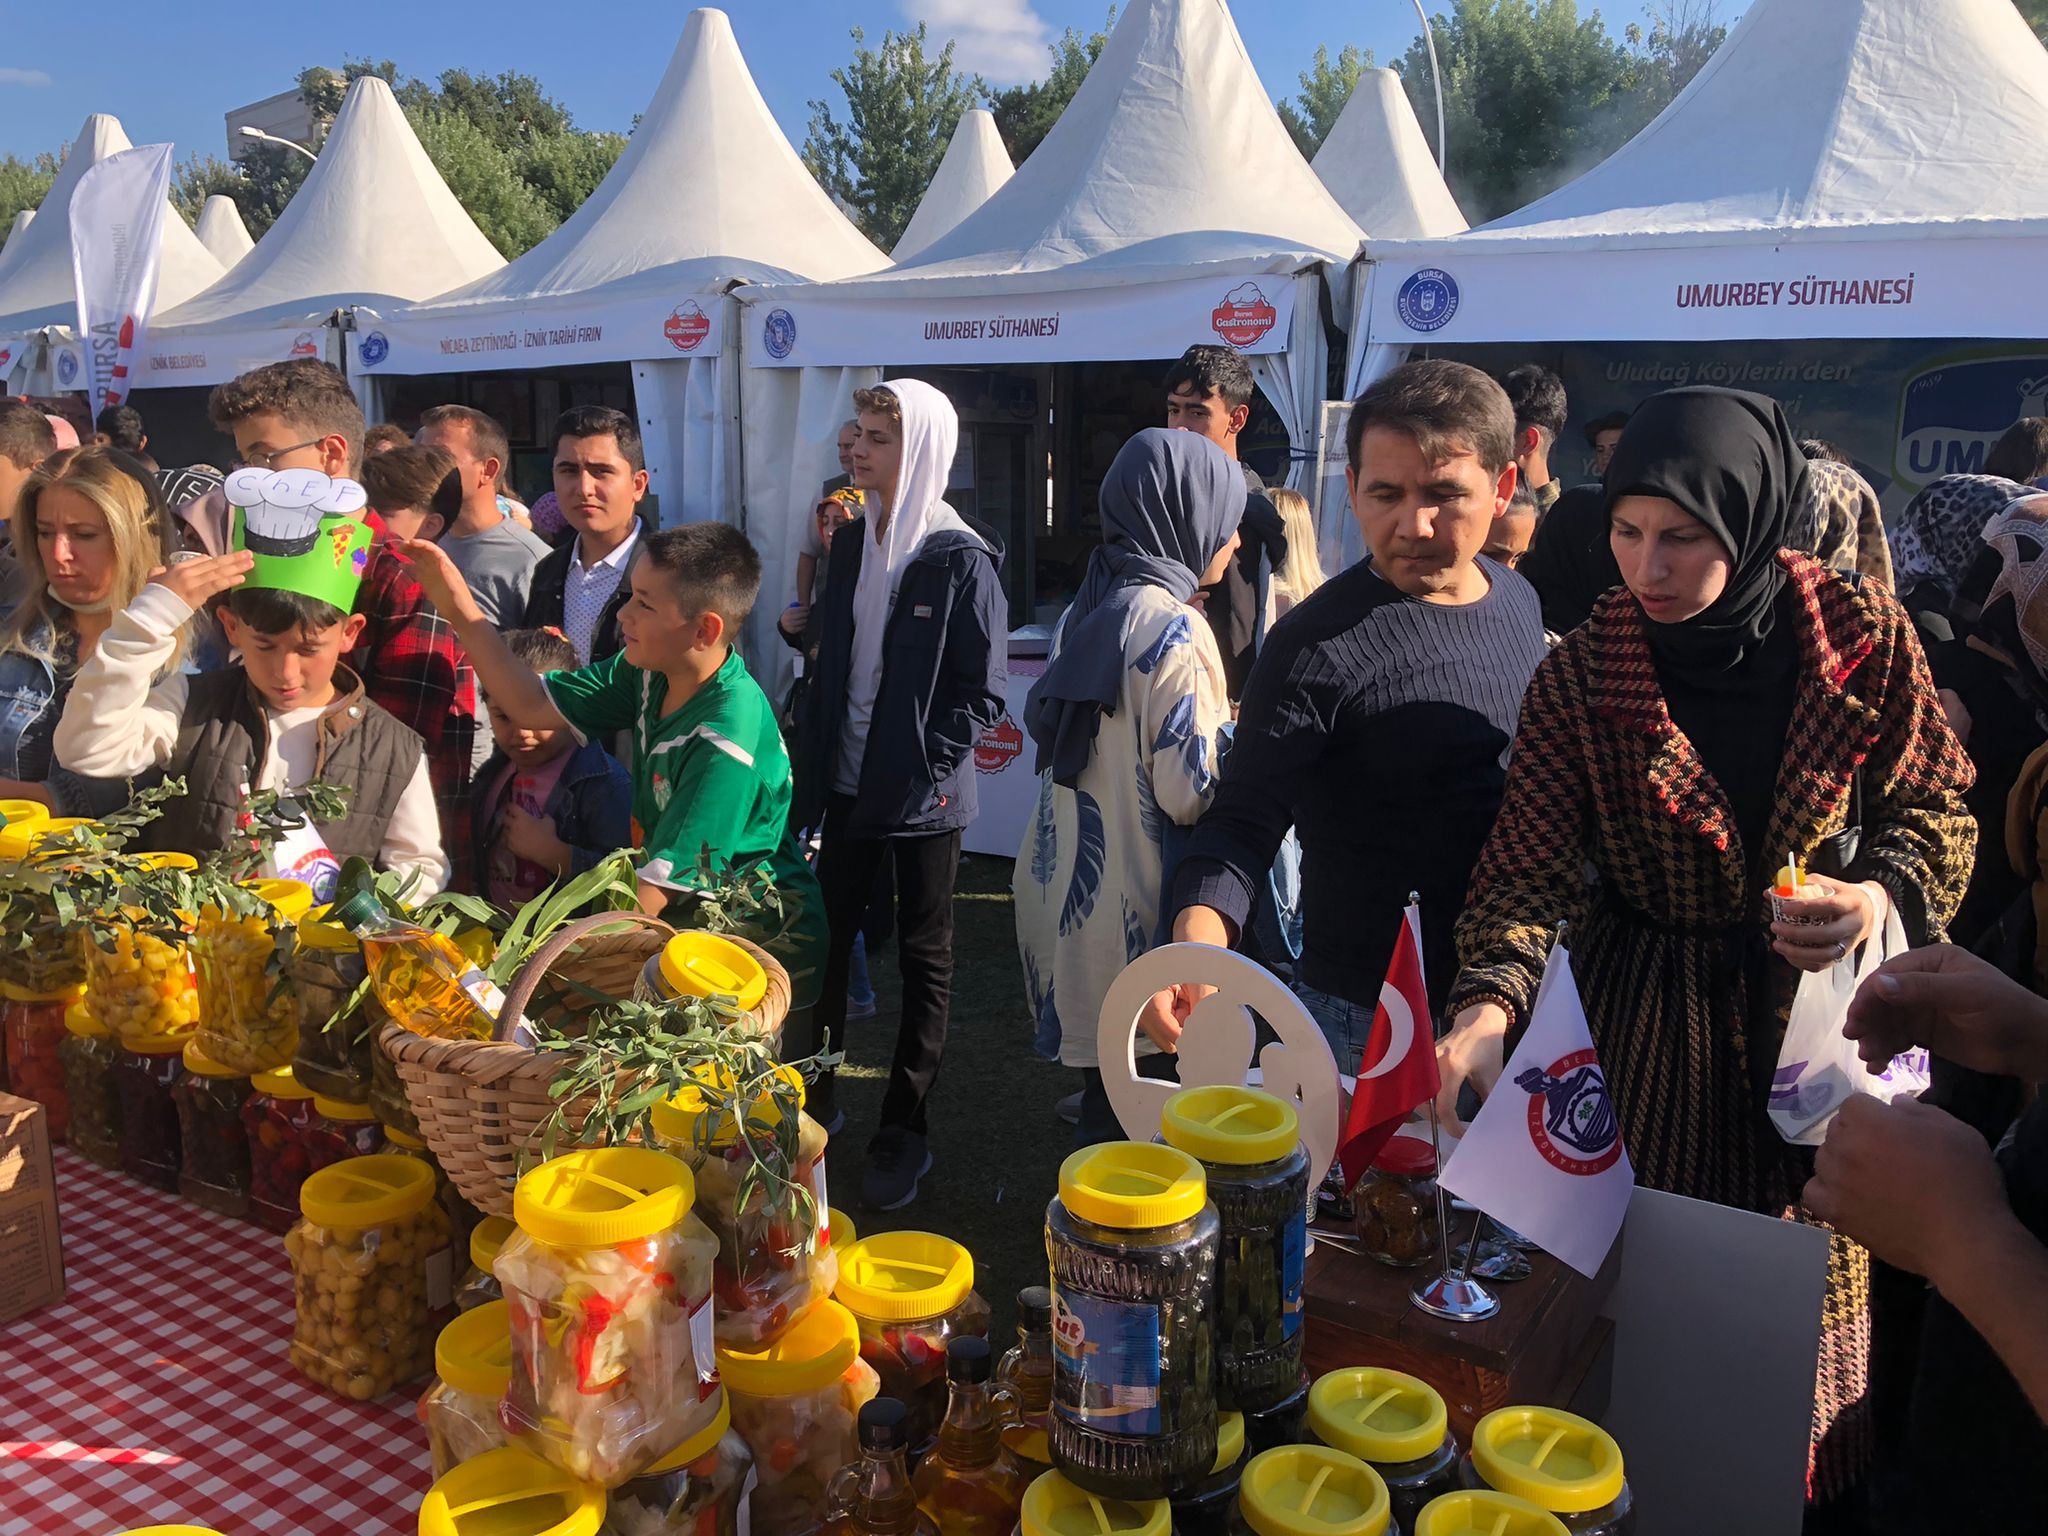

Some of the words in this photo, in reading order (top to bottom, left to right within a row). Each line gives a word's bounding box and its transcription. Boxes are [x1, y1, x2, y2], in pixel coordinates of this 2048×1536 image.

[1417, 270, 1444, 280] BURSA
[1676, 281, 1785, 308] UMURBEY
[1788, 272, 1915, 305] SÜTHANESİ
[924, 320, 987, 340] UMURBEY
[988, 311, 1060, 338] SÜTHANESİ
[1216, 316, 1272, 327] Gastronomi
[524, 328, 548, 348] İZNİK
[549, 324, 577, 345] TARİHİ
[577, 325, 602, 343] FIRIN
[1606, 361, 1691, 386] Uludağ
[1695, 360, 1853, 386] Köylerin'den
